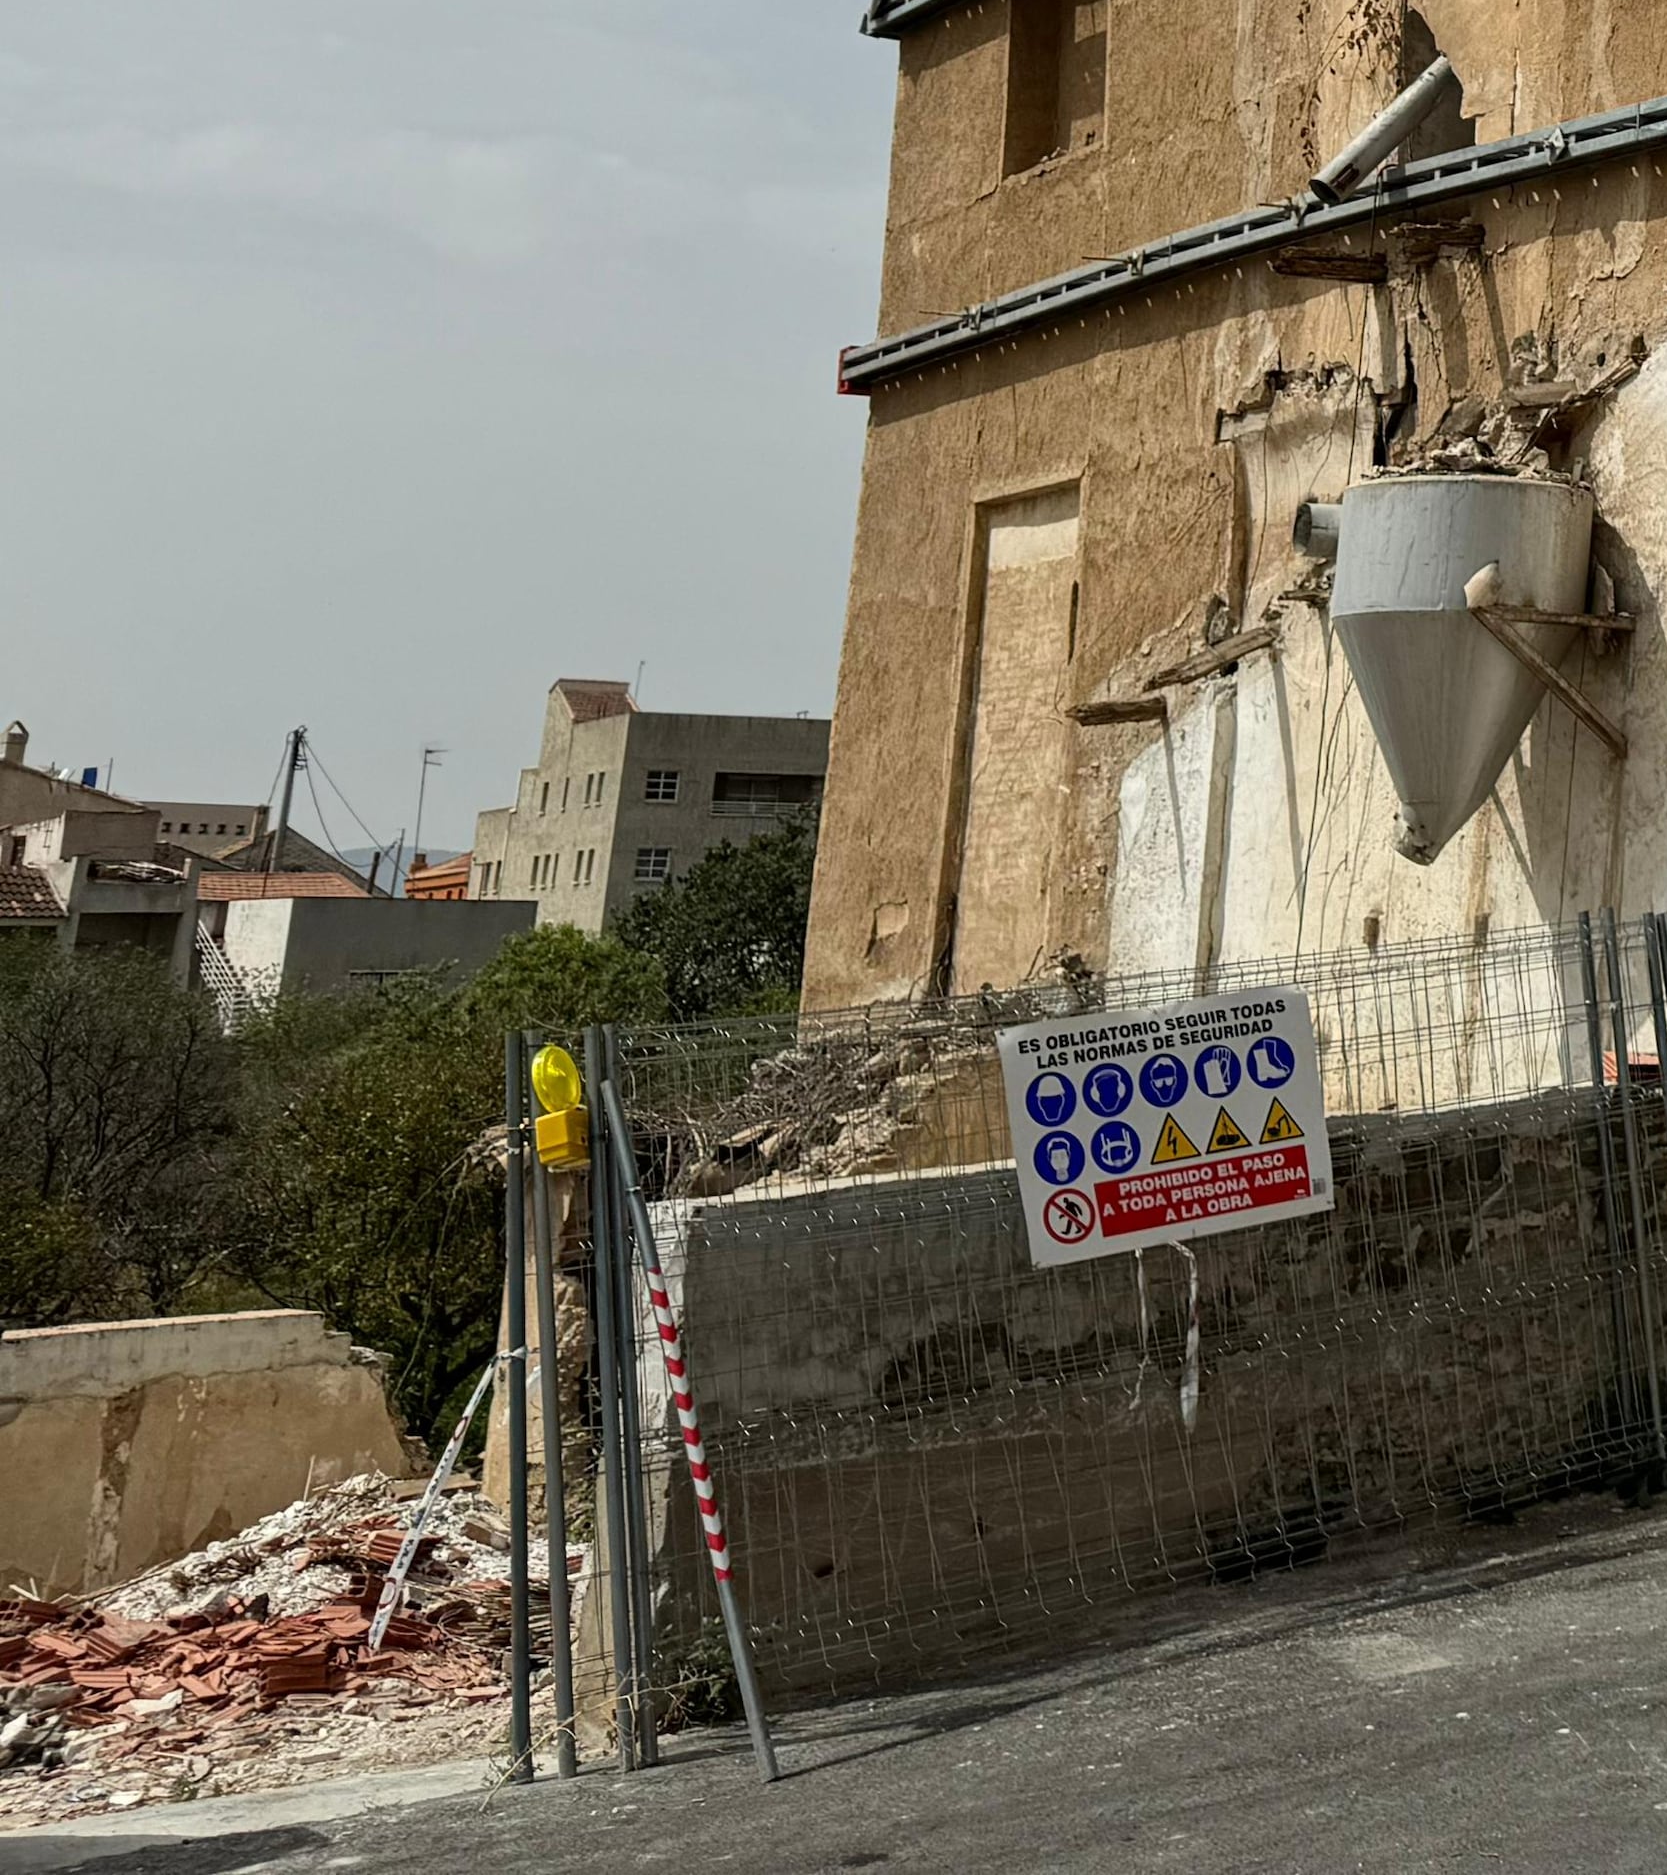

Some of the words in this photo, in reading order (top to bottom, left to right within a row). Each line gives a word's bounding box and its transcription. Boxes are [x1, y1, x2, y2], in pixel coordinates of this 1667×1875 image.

[1018, 1037, 1041, 1054] ES
[1046, 1020, 1160, 1050] OBLIGATORIO
[1165, 1009, 1227, 1031] SEGUIR
[1231, 999, 1286, 1020] TODAS
[1037, 1051, 1069, 1069] LAS
[1074, 1040, 1147, 1063] NORMAS
[1153, 1033, 1175, 1050] DE
[1180, 1019, 1273, 1045] SEGURIDAD
[1103, 1203, 1115, 1217] A
[1118, 1193, 1167, 1214] TODA
[1171, 1177, 1250, 1203] PERSONA
[1254, 1166, 1306, 1187] AJENA
[1119, 1167, 1213, 1197] PROHIBIDO
[1217, 1162, 1239, 1176] EL
[1242, 1153, 1285, 1172] PASO
[1165, 1208, 1177, 1223] A
[1181, 1204, 1203, 1218] LA
[1207, 1194, 1253, 1213] OBRA
